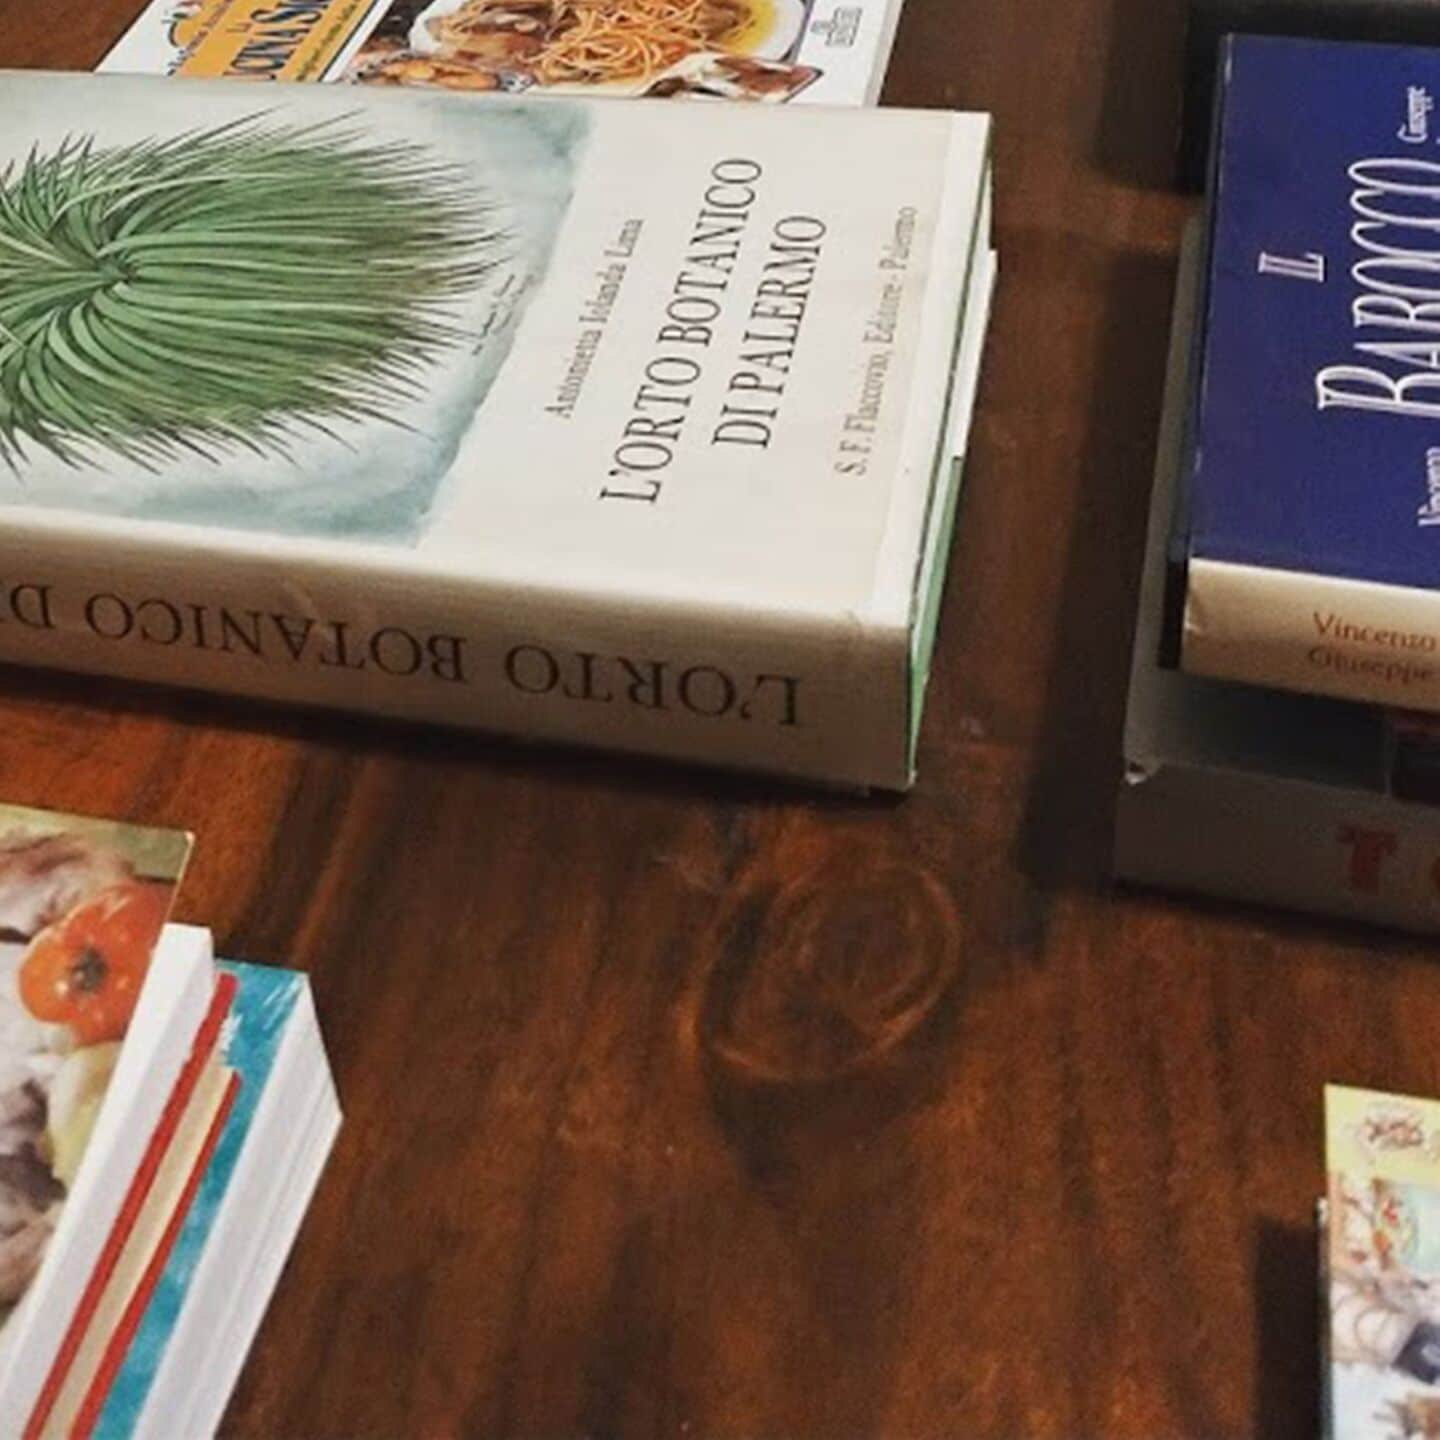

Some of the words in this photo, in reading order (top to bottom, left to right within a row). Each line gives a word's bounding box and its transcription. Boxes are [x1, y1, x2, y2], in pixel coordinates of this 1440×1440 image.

[604, 218, 644, 257] Lima
[1258, 250, 1325, 283] IL
[728, 215, 827, 396] PALERMO
[1316, 157, 1440, 419] BAROCCO
[598, 356, 701, 504] L'ORTO
[656, 158, 762, 347] BOTANICO
[711, 404, 778, 449] DI
[84, 591, 470, 685] BOTANICO
[1312, 611, 1437, 652] Vincenzo
[503, 642, 803, 727] L'ORTO
